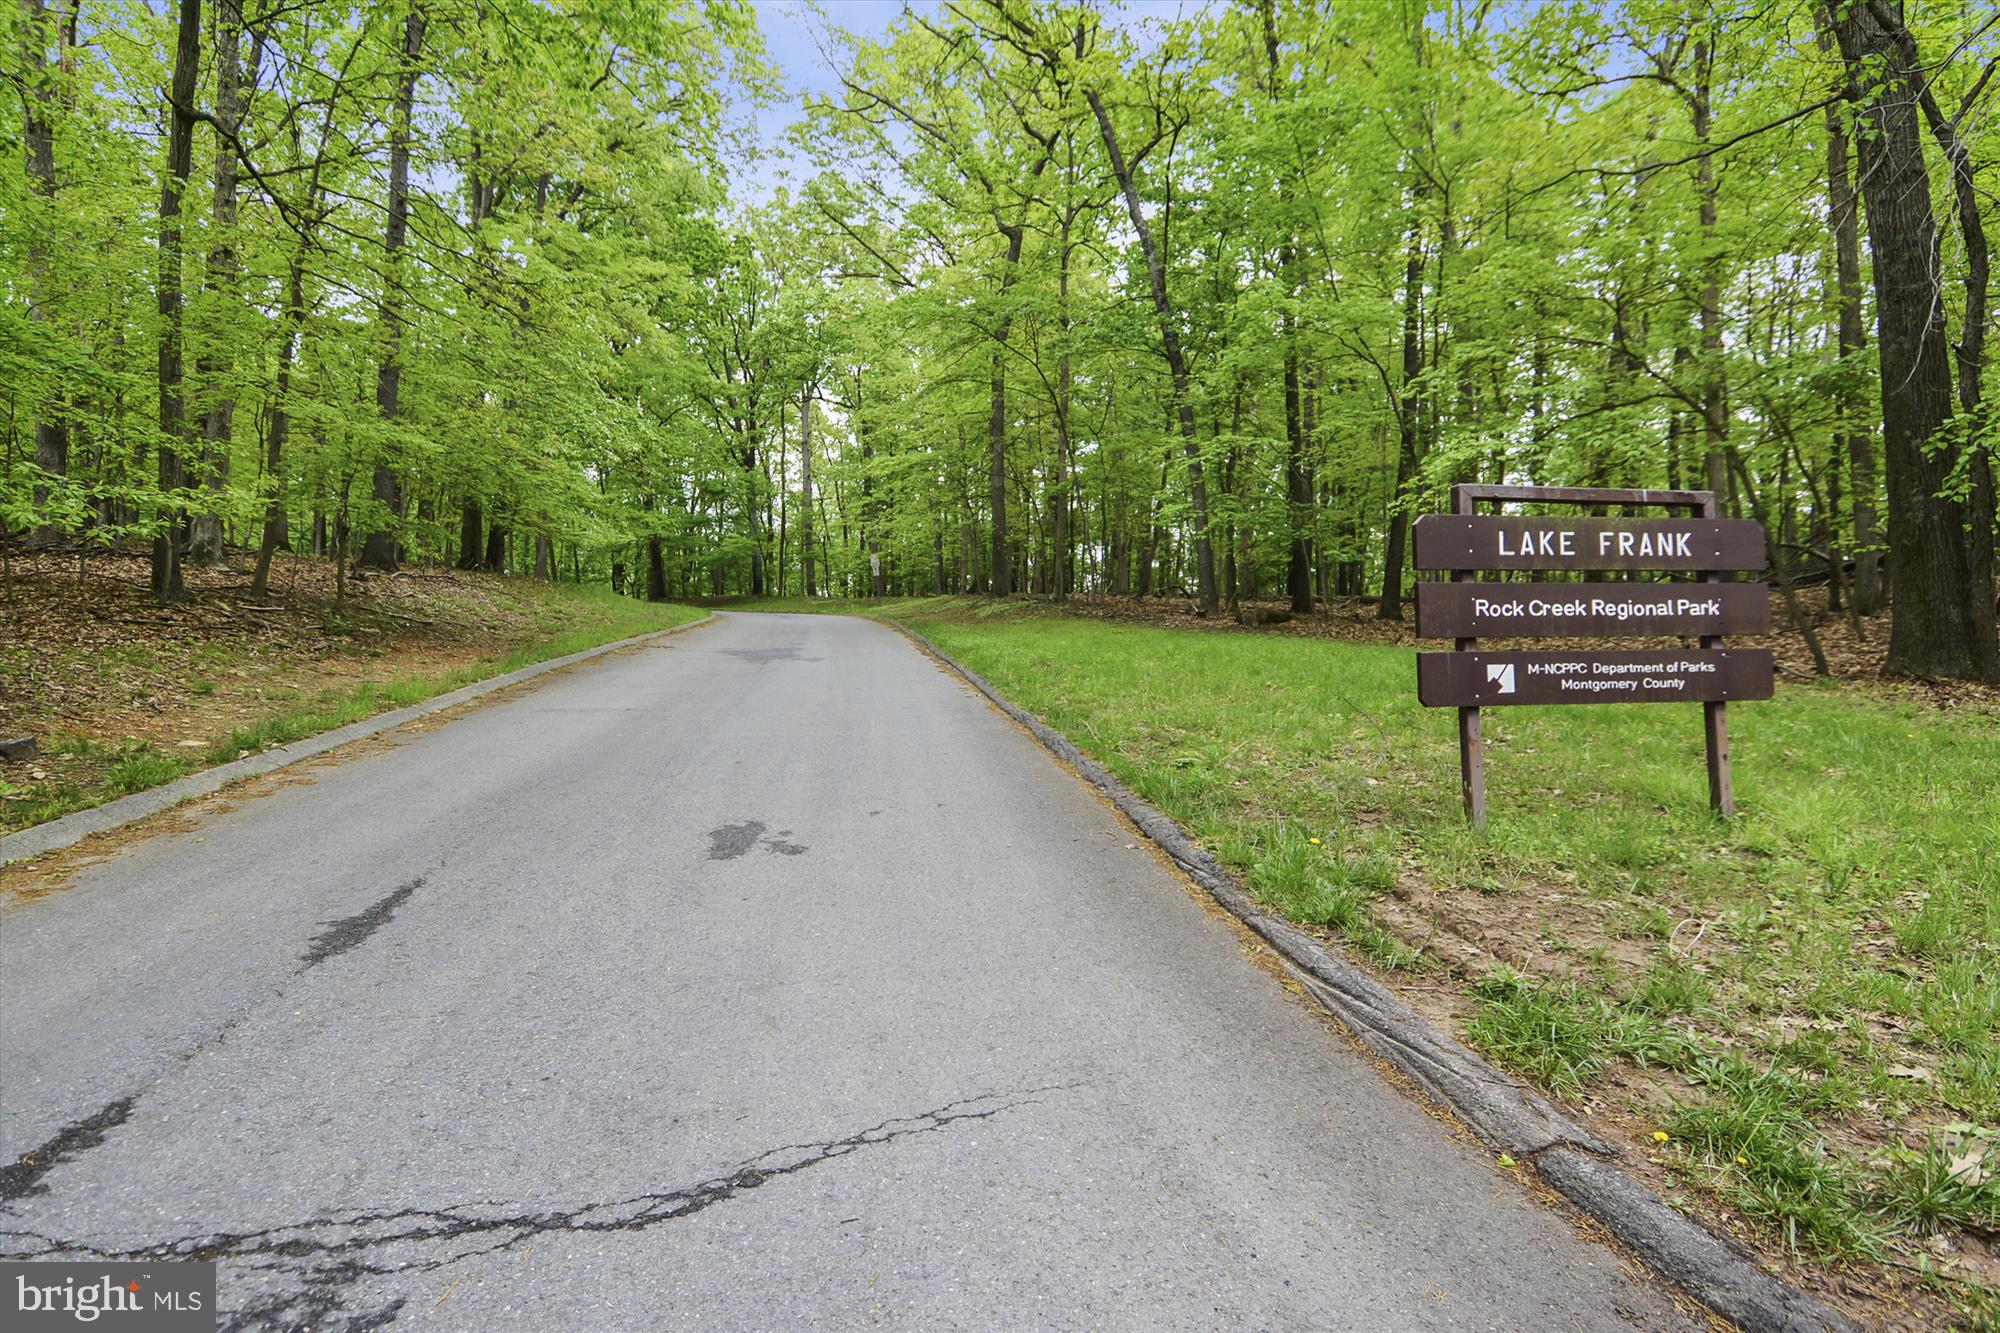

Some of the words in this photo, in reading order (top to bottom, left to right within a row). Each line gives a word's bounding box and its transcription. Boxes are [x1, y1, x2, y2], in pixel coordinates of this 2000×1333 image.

[1498, 530, 1576, 556] LAKE
[1599, 531, 1692, 557] FRANK
[1475, 599, 1525, 617] Rock
[1528, 599, 1587, 617] Creek
[1591, 599, 1674, 621] Regional
[1677, 599, 1721, 616] Park
[1527, 663, 1588, 675] M-NCPPC
[1592, 662, 1664, 675] Department
[1666, 662, 1679, 673] of
[1680, 661, 1716, 673] Parks
[1561, 678, 1638, 692] Montgomery
[1642, 677, 1686, 690] County
